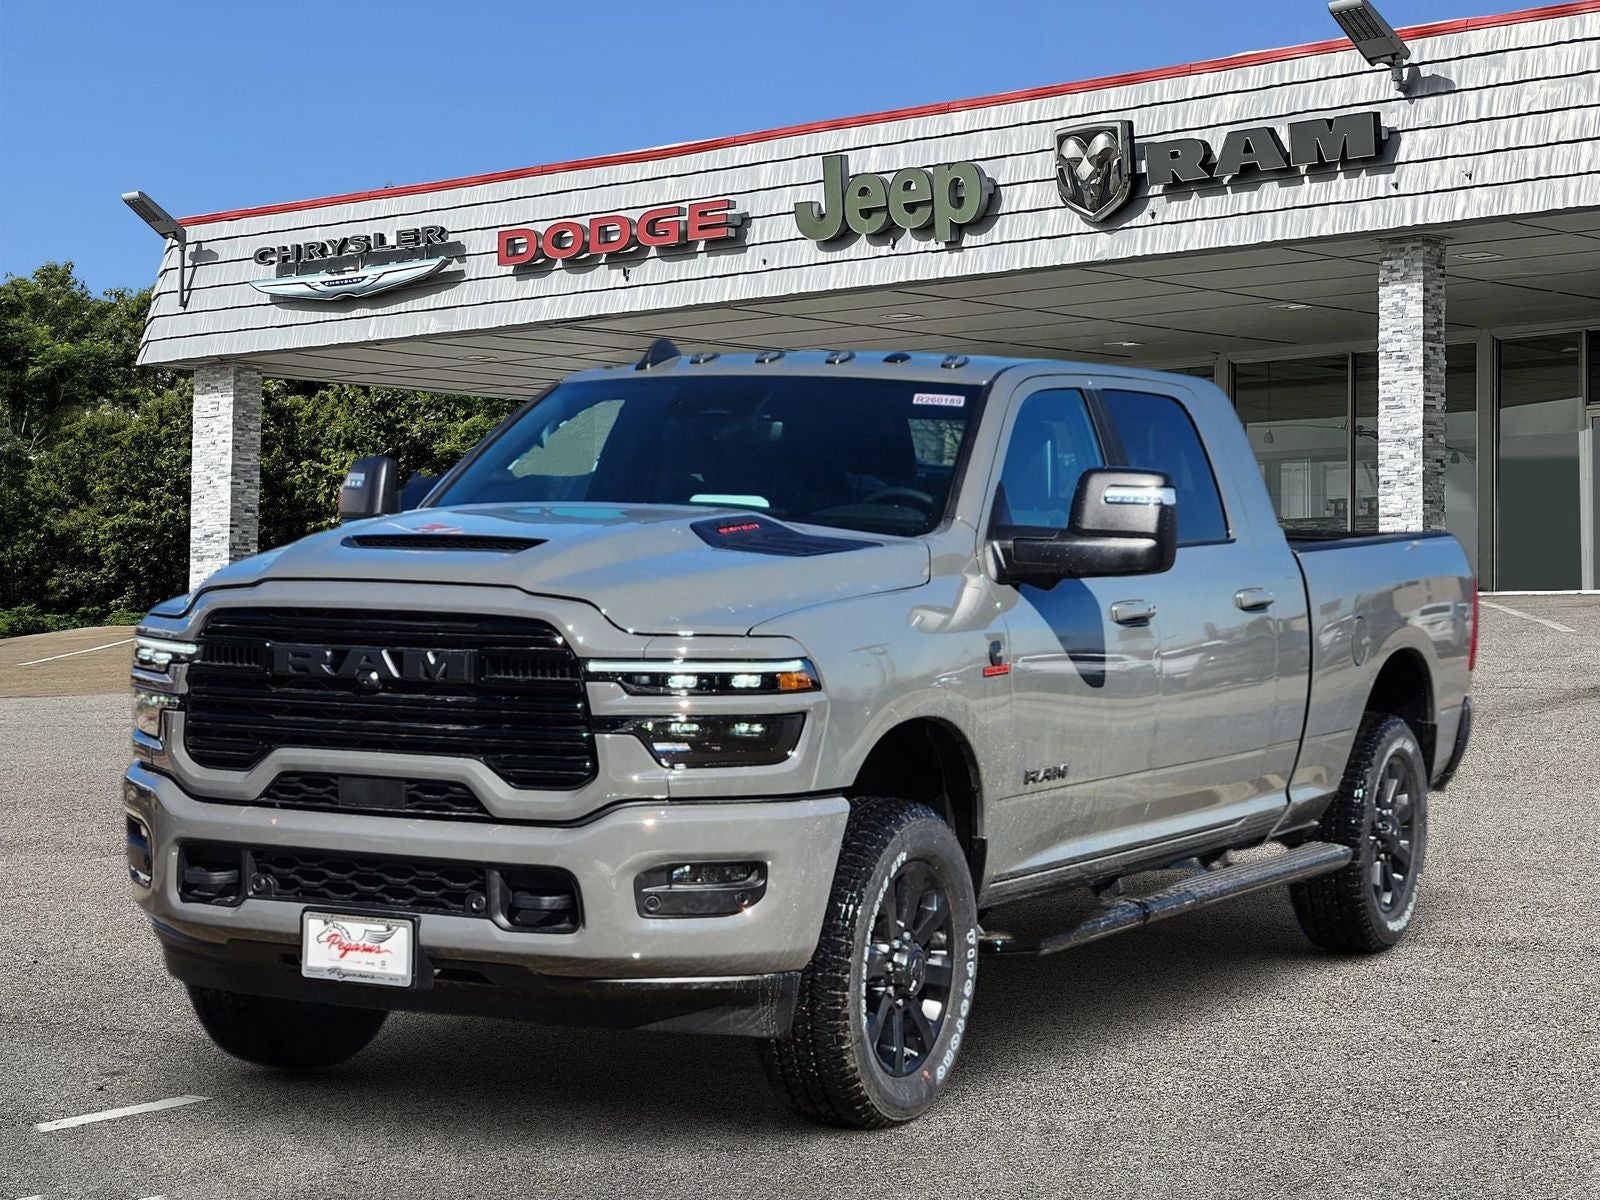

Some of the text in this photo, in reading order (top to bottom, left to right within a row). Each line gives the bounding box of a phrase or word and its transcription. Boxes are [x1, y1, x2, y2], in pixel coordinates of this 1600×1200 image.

[1146, 112, 1380, 186] RAM
[795, 155, 992, 241] Jeep
[253, 225, 448, 266] CHRYSLER
[497, 199, 736, 267] DODGE
[273, 643, 474, 683] RAM
[1023, 763, 1068, 785] RAM
[327, 933, 393, 959] Pegasus
